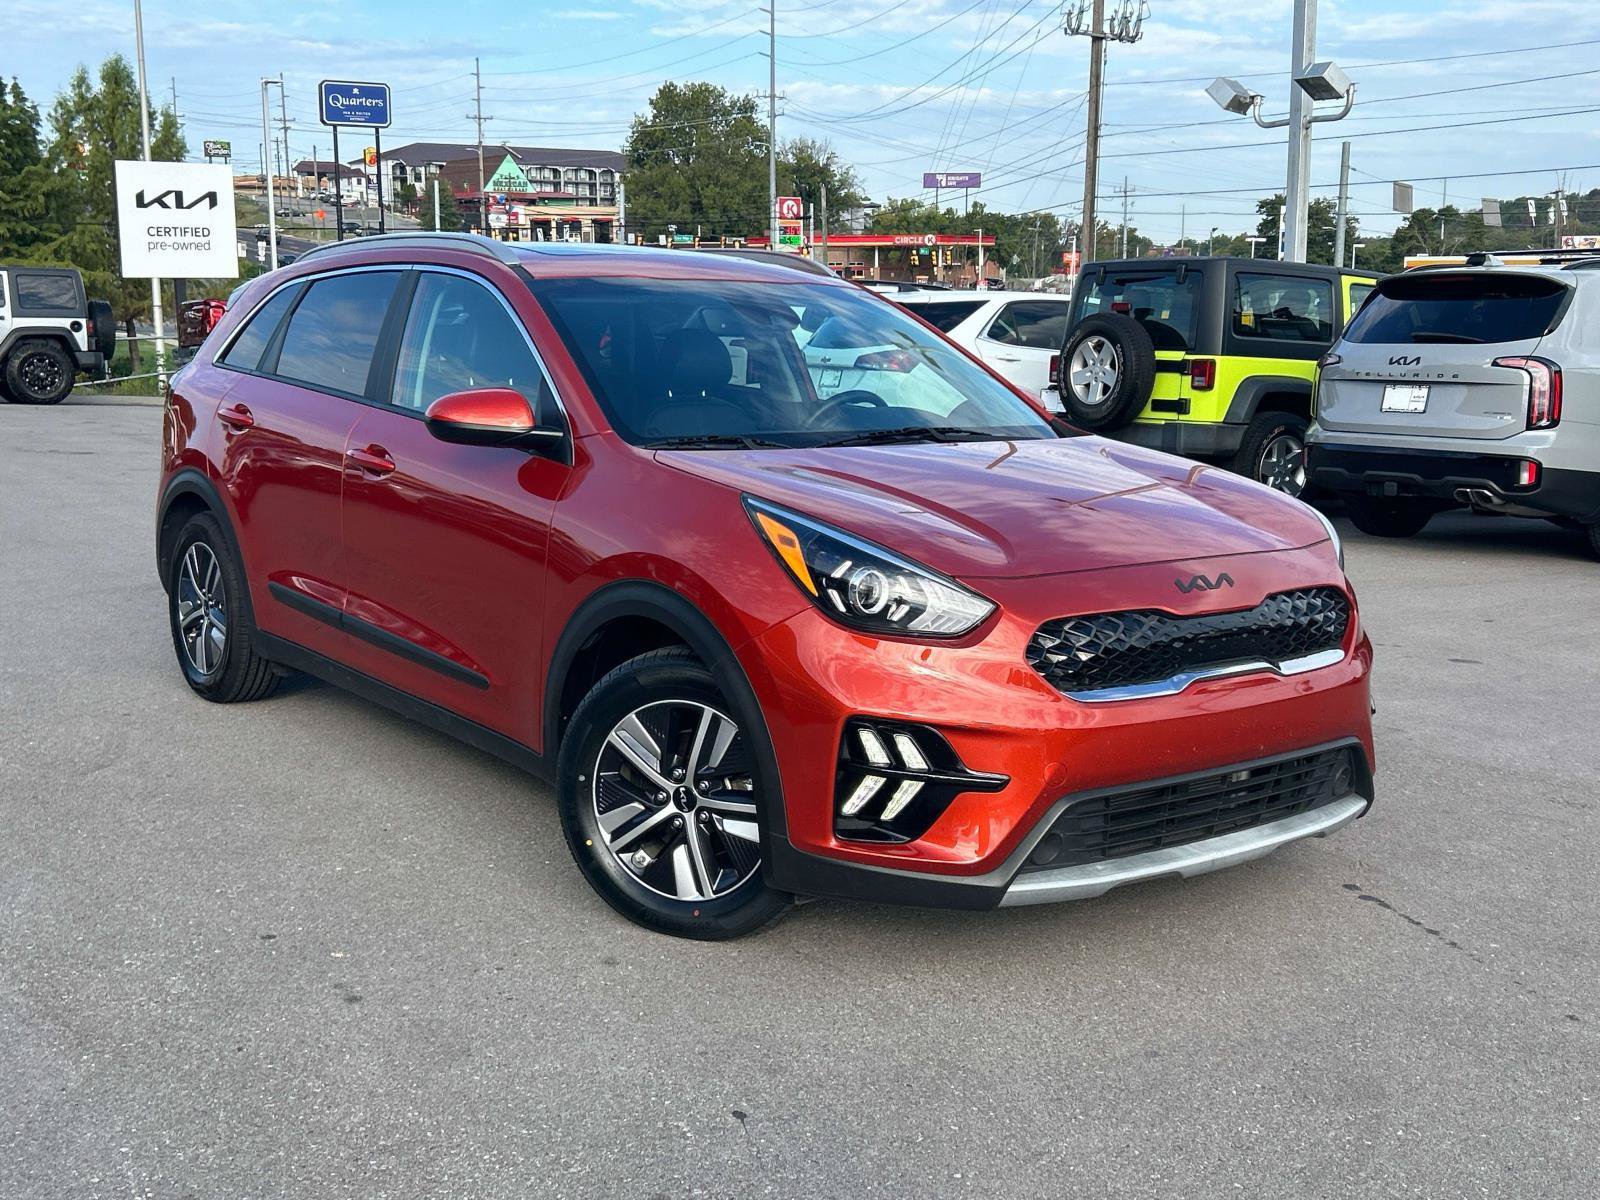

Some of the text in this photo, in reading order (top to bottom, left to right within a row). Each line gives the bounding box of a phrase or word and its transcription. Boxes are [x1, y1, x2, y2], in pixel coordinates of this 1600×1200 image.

[329, 93, 384, 109] Quarters
[136, 189, 217, 210] KIA
[147, 226, 211, 238] CERTIFIED
[148, 240, 211, 252] pre-owned
[895, 236, 924, 244] CIRCLE
[1388, 356, 1421, 366] KIA
[1355, 371, 1460, 379] TELLURIDE
[1174, 573, 1234, 593] KIA
